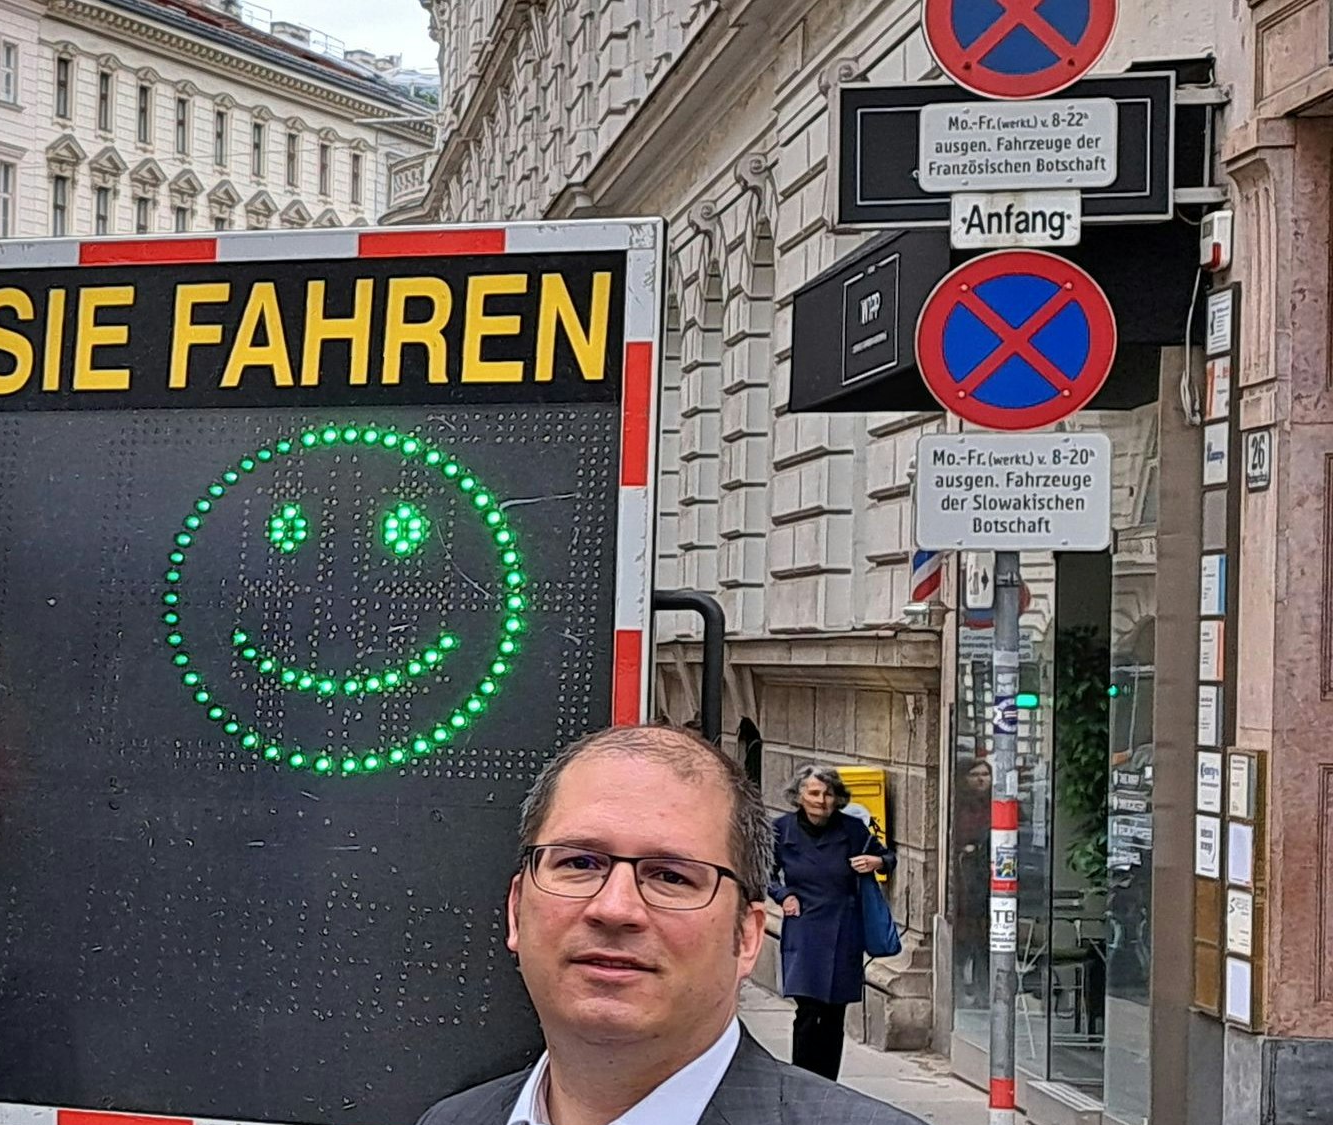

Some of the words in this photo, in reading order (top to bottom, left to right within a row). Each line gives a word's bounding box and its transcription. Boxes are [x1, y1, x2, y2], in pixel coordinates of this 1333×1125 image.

[935, 140, 992, 156] ausgen.
[997, 137, 1071, 153] Fahrzeuge
[1077, 134, 1102, 149] der
[929, 159, 1031, 176] Französischen
[1036, 156, 1106, 172] Botschaft
[965, 203, 1066, 240] Anfang
[169, 271, 611, 389] FAHREN
[1251, 434, 1265, 471] 26
[935, 475, 999, 491] ausgen.
[1006, 472, 1092, 491] Fahrzeuge
[941, 495, 969, 511] der
[973, 494, 1084, 511] Slowakischen
[973, 517, 1051, 533] Botschaft
